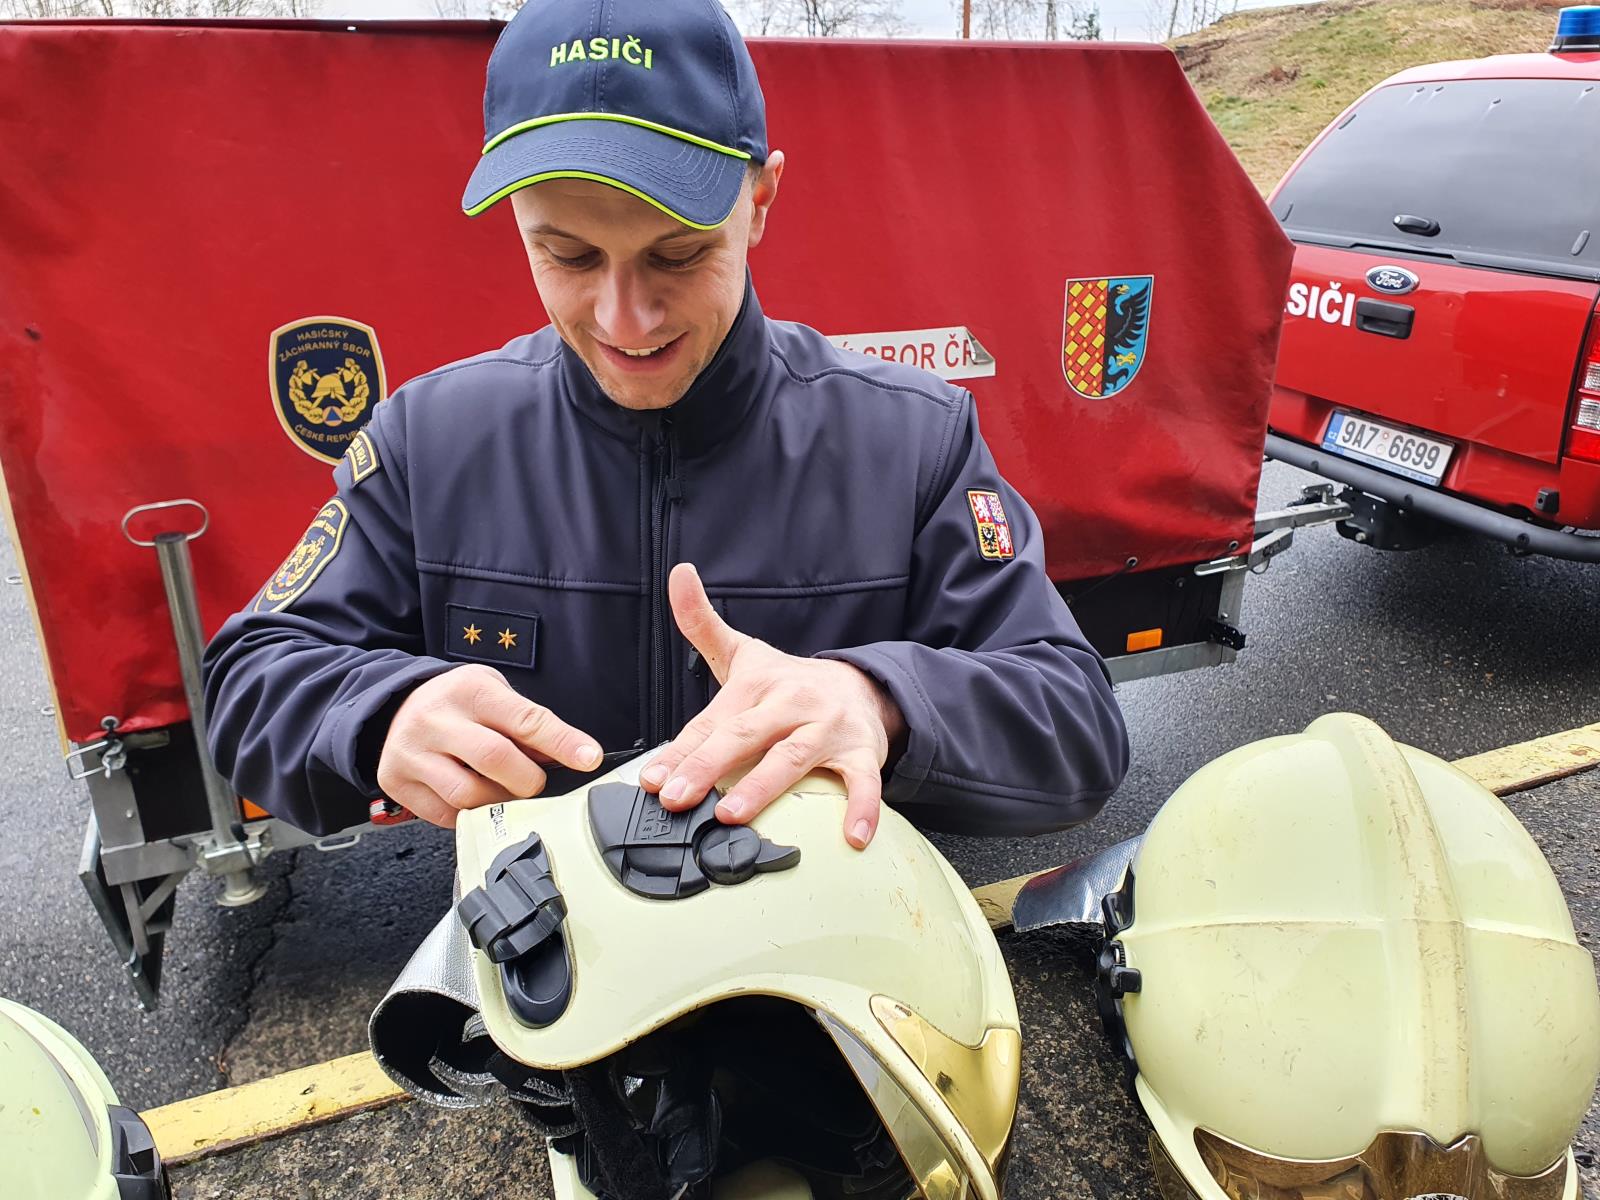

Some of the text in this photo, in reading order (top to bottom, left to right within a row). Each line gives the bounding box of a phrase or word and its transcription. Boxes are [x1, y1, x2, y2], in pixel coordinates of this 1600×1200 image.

[550, 34, 653, 70] HASIČI
[1284, 281, 1356, 326] SIČI
[296, 328, 349, 341] HASIČSKÝ
[279, 341, 371, 362] ZÁCHRANNÝ SBOR
[295, 424, 325, 443] ČESKÉ
[1327, 431, 1337, 440] CZ
[1342, 420, 1441, 470] 9A7 6699
